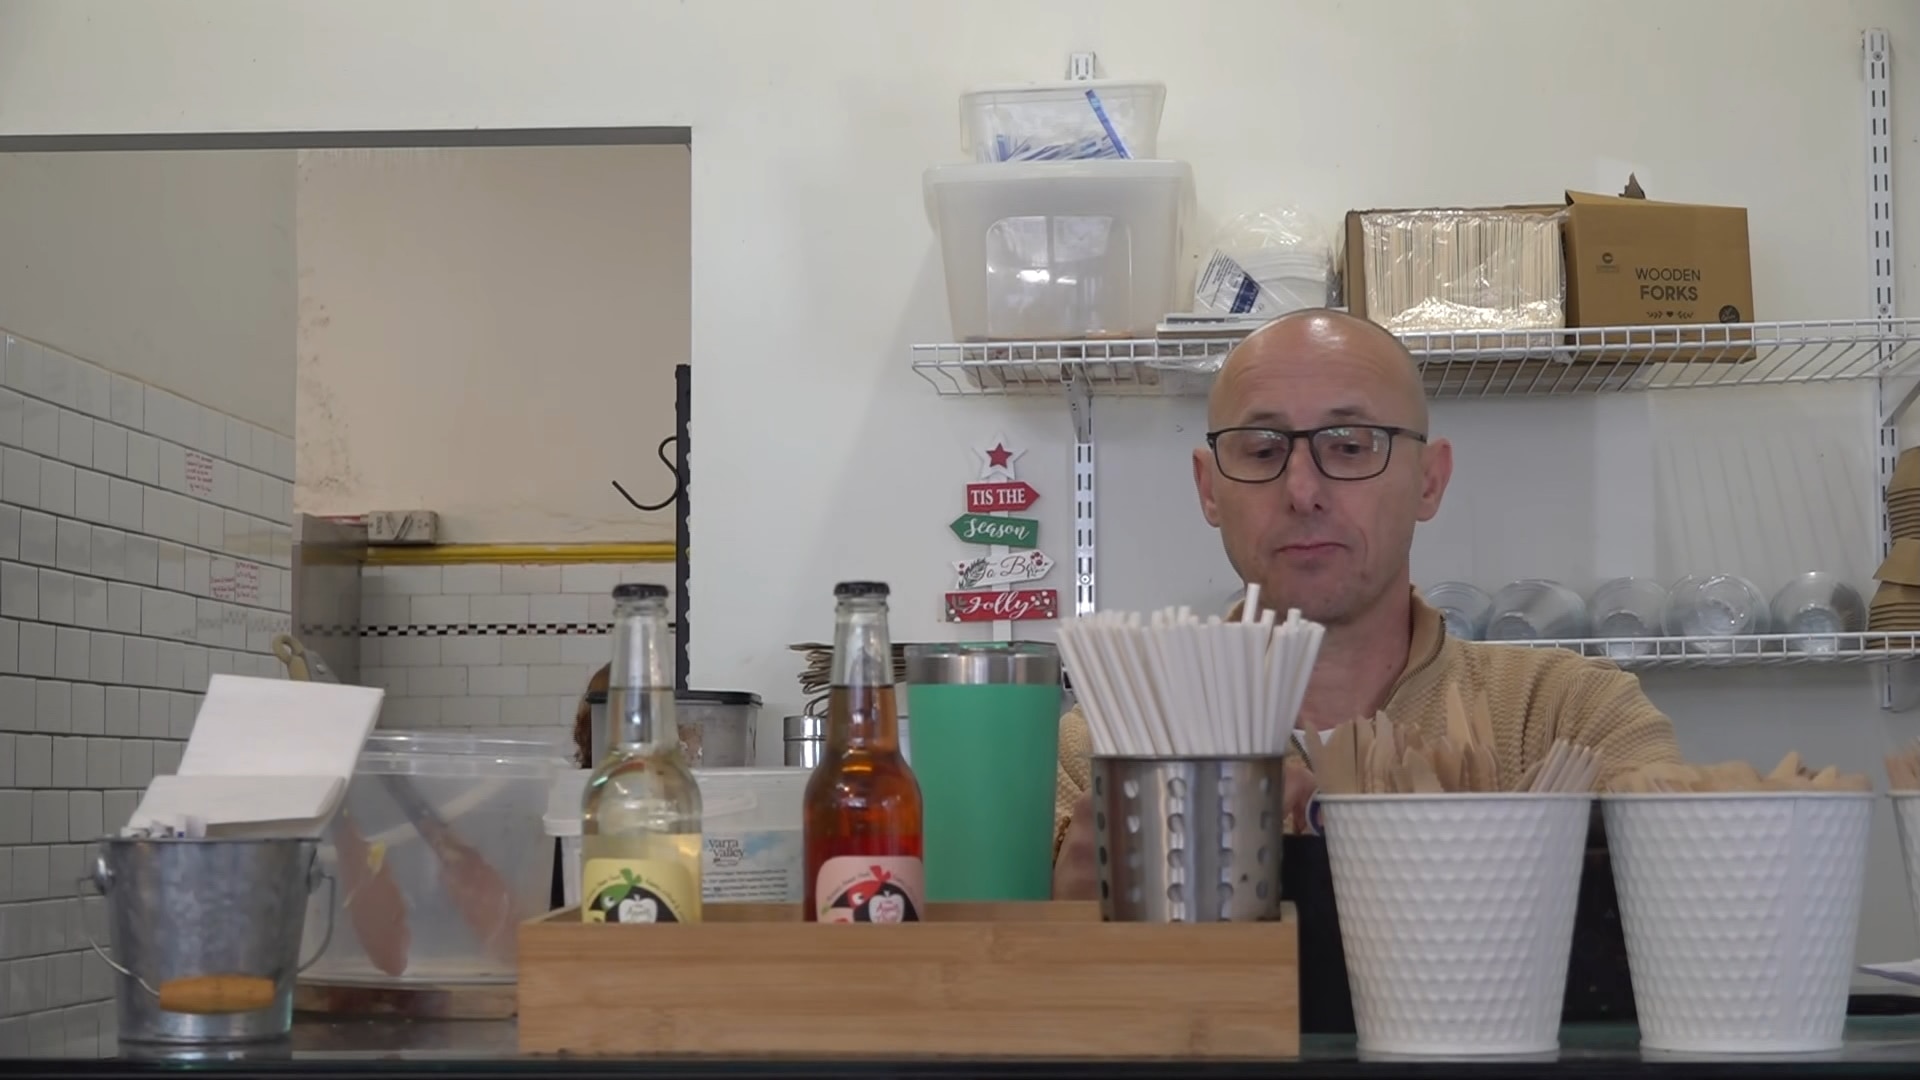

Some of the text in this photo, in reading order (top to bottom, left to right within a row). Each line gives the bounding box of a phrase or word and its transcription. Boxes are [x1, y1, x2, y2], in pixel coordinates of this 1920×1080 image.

[1635, 267, 1701, 282] WOODEN
[1640, 284, 1699, 302] FORKS
[970, 487, 1026, 505] TIS THE
[963, 518, 1030, 540] Season
[963, 590, 1037, 619] Jolly
